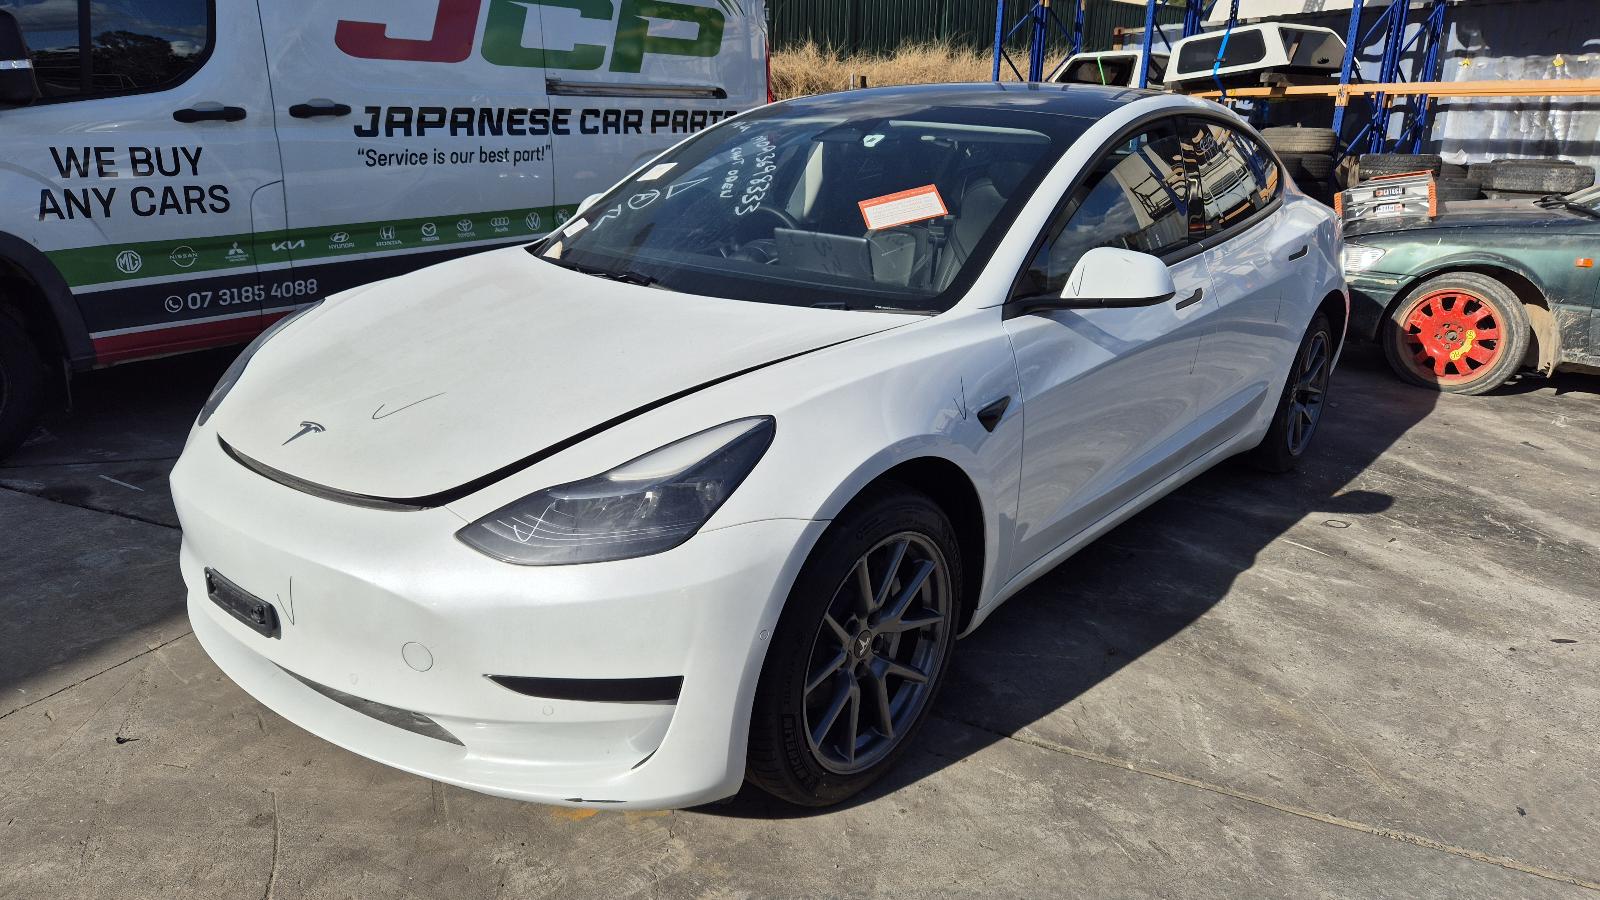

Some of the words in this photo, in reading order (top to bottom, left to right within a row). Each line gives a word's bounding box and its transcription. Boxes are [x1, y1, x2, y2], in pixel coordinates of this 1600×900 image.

[335, 0, 726, 73] JCP
[354, 106, 572, 137] JAPANESE
[580, 109, 643, 134] CAR
[49, 147, 120, 178] WE
[129, 147, 203, 178] BUY
[433, 148, 445, 165] is
[450, 151, 474, 165] our
[479, 146, 510, 163] best
[38, 187, 116, 221] ANY
[131, 184, 231, 217] CARS
[119, 252, 140, 271] MG
[169, 252, 198, 260] NISSAN
[328, 242, 355, 250] HYUNDAI
[187, 291, 213, 310] 07
[218, 285, 265, 306] 3185
[270, 278, 318, 299] 4088
